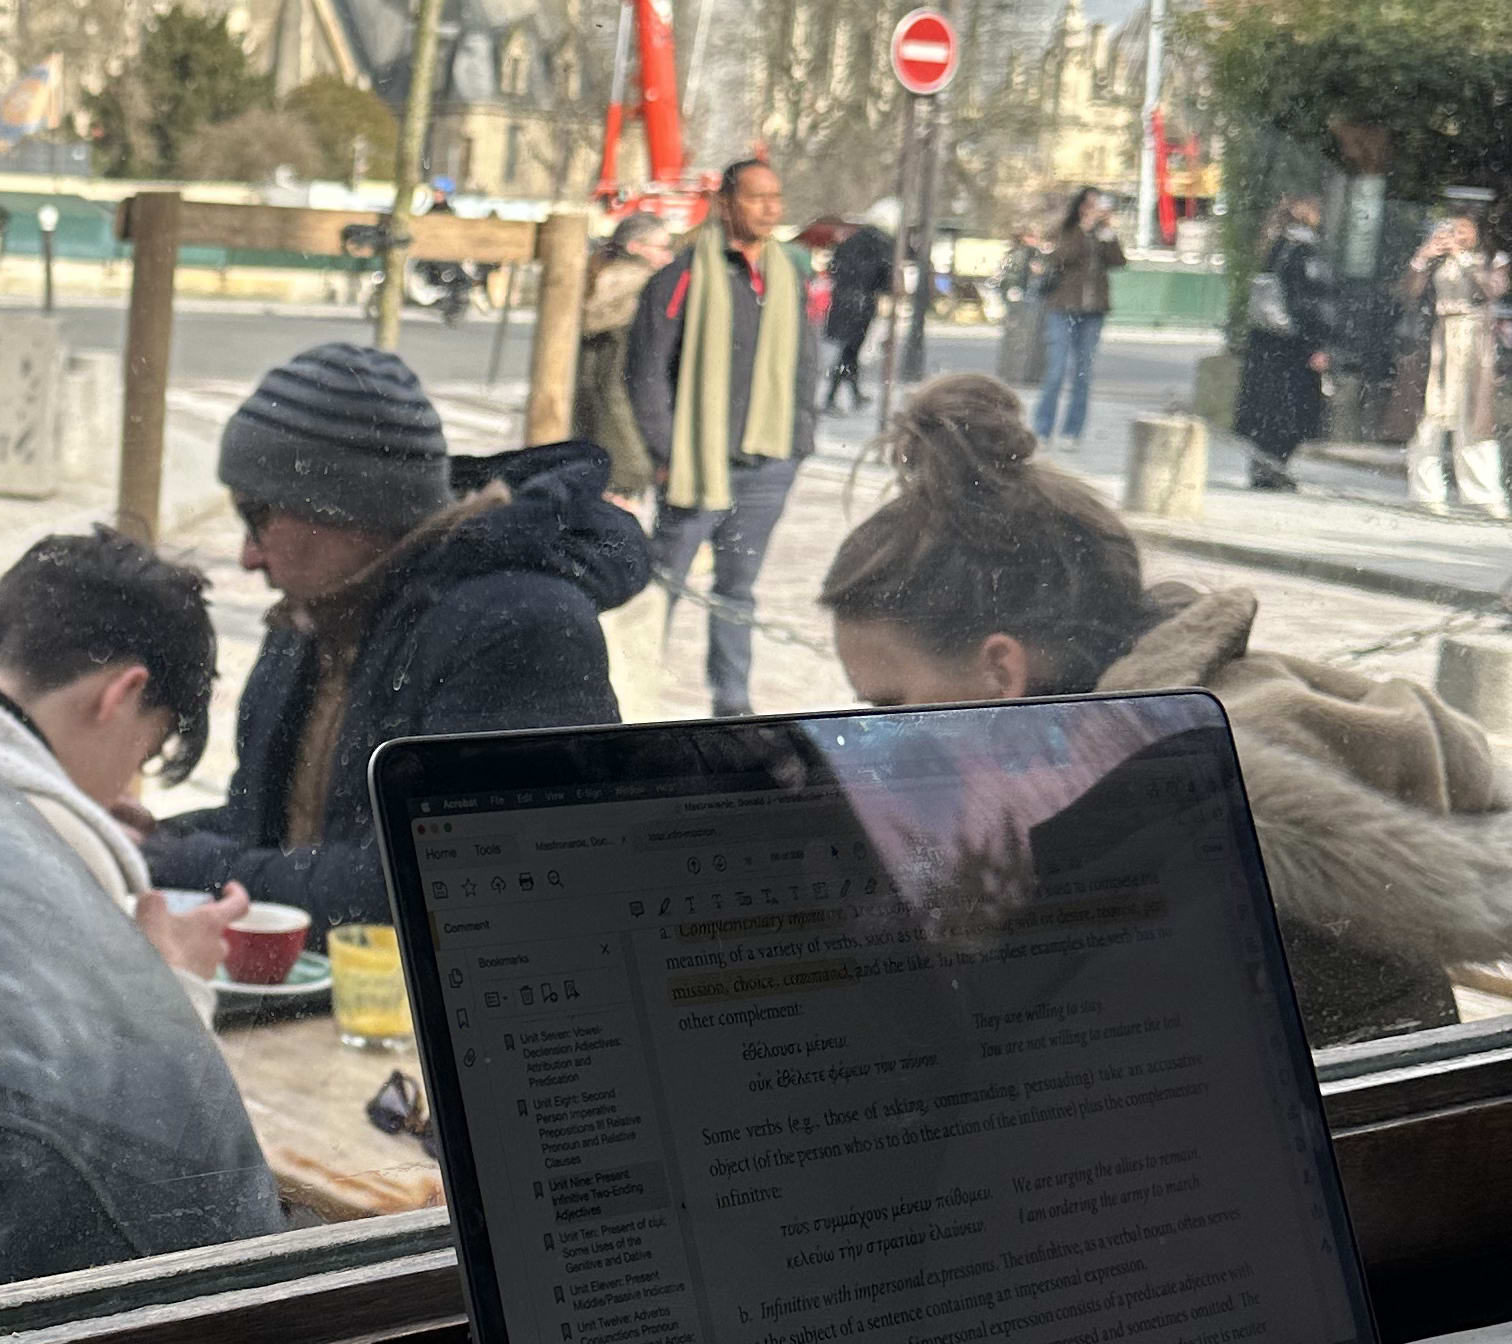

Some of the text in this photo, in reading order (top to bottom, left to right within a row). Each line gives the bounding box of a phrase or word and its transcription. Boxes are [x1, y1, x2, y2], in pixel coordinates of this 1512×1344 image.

[442, 798, 478, 809] Acrobat
[516, 793, 533, 803] Edit
[544, 791, 565, 800] View
[424, 842, 502, 860] Home Tools
[443, 920, 491, 933] Comment
[477, 953, 529, 968] Bookmarks
[665, 932, 863, 969] meaning of a variety of verbs,
[677, 1000, 805, 1030] other complement:
[701, 1126, 741, 1144] Some
[745, 1117, 783, 1137] verbs
[823, 1107, 860, 1125] those
[864, 1101, 881, 1119] of
[1023, 1067, 1095, 1098] persuading)
[1097, 1063, 1124, 1081] take
[1127, 1064, 1143, 1076] an
[1146, 1053, 1204, 1073] accusative
[708, 1155, 750, 1179] object
[772, 1147, 795, 1165] the
[796, 1144, 841, 1167] person
[844, 1135, 873, 1154] who
[871, 1134, 885, 1149] is
[885, 1132, 900, 1147] to
[899, 1128, 918, 1145] do
[919, 1124, 943, 1142] the
[941, 1120, 980, 1138] action
[981, 1114, 996, 1131] of
[994, 1112, 1017, 1129] the
[1078, 1098, 1104, 1120] plus
[1102, 1093, 1125, 1110] the
[1123, 1082, 1211, 1108] complementary
[1010, 1175, 1032, 1193] We
[1033, 1175, 1053, 1189] are
[1054, 1166, 1095, 1188] urging
[1092, 1161, 1113, 1178] the
[1113, 1156, 1145, 1174] allies
[1144, 1154, 1158, 1168] to
[1016, 1207, 1025, 1223] I
[1025, 1208, 1046, 1222] am
[1047, 1196, 1099, 1218] ordering
[1098, 1190, 1118, 1207] the
[1118, 1187, 1152, 1204] army
[1150, 1182, 1164, 1197] to
[737, 1304, 753, 1323] b.
[758, 1294, 826, 1319] Infinitive
[822, 1284, 851, 1306] with
[852, 1269, 926, 1302] impersonal
[925, 1259, 999, 1287] expressions.
[999, 1250, 1024, 1269] The
[1083, 1238, 1097, 1251] as
[1096, 1236, 1105, 1248] a
[1105, 1223, 1141, 1246] verbal
[1176, 1213, 1206, 1231] often
[1206, 1208, 1241, 1225] serves
[839, 1315, 856, 1335] of
[855, 1319, 864, 1332] a
[866, 1306, 922, 1329] sentence
[924, 1289, 996, 1316] containing
[994, 1286, 1012, 1300] an
[1012, 1266, 1081, 1298] impersonal
[1082, 1257, 1148, 1284] expression.
[988, 1309, 1054, 1338] expression
[1054, 1296, 1102, 1320] consists
[1102, 1290, 1117, 1309] of
[1116, 1293, 1124, 1305] a
[1124, 1279, 1178, 1309] predicate
[1178, 1269, 1227, 1294] adjective
[1228, 1259, 1255, 1280] with
[1100, 1319, 1124, 1341] and
[1125, 1310, 1188, 1334] sometimes
[1237, 1289, 1260, 1308] The
[1219, 1327, 1231, 1343] is
[1231, 1320, 1268, 1340] neuter
